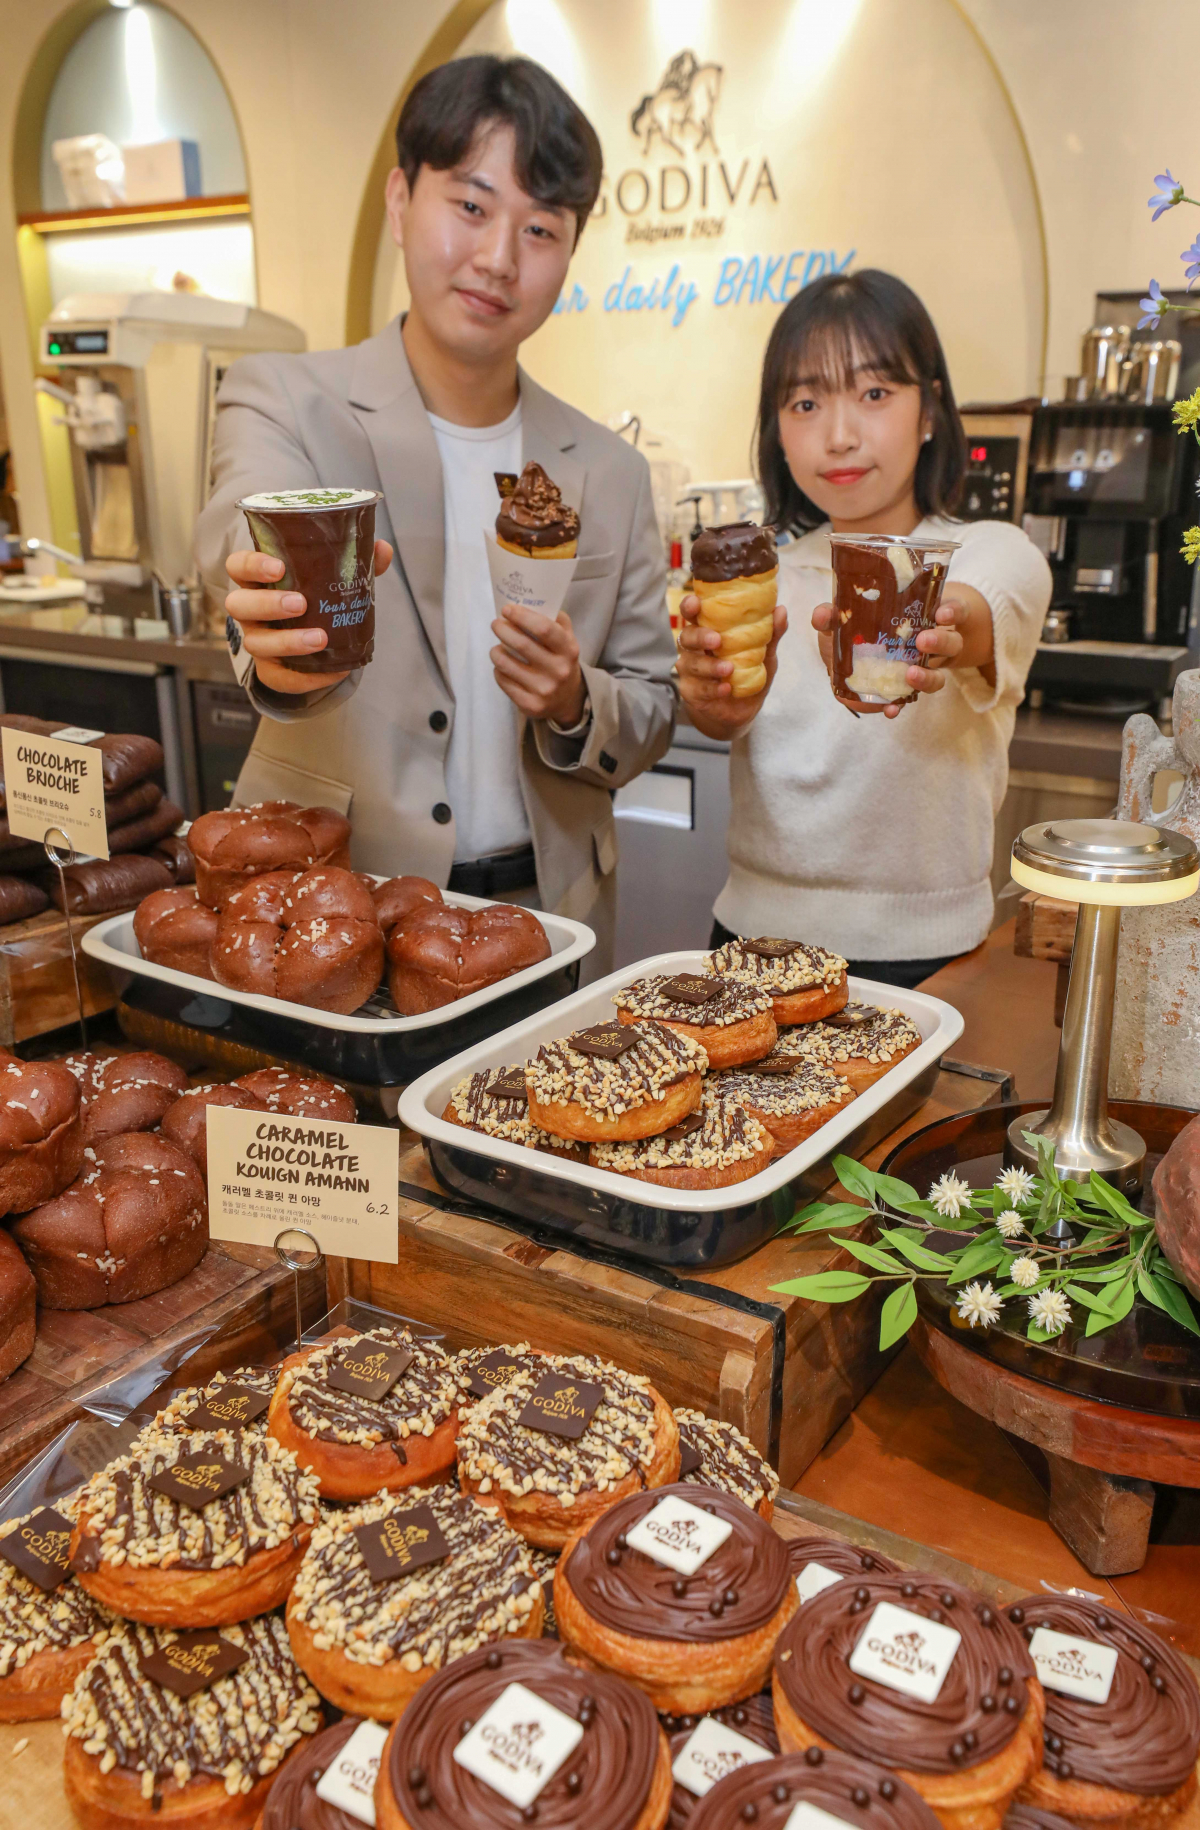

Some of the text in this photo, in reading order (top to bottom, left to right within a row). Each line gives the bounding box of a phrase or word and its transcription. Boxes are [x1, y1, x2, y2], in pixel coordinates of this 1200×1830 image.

[603, 264, 698, 327] daily
[319, 599, 347, 614] Your
[332, 609, 367, 628] BAKERY
[876, 631, 903, 645] Your
[17, 746, 88, 777] CHOCOLATE
[26, 767, 80, 794] BRIOCHE
[49, 799, 69, 811] 브리오슈
[89, 807, 102, 819] 5.8
[671, 981, 708, 995] GODIVA
[583, 1034, 623, 1048] GODIVA
[500, 1079, 526, 1087] GODI
[256, 1122, 349, 1150] CARAMEL
[246, 1142, 360, 1172] CHOCOLATE
[236, 1161, 370, 1193] KOUIGN AMANN
[222, 1184, 321, 1207] 캐러멜 초콜릿 퀸 아망
[365, 1202, 390, 1216] 6.2
[343, 1359, 391, 1382] GODIVA
[477, 1367, 512, 1385] GODI
[206, 1401, 248, 1421] GODIVA
[533, 1396, 586, 1418] GODIVA
[171, 1466, 221, 1492] GODIVA
[21, 1527, 71, 1570] GODIVA
[383, 1518, 412, 1566] GODIVA
[646, 1521, 702, 1555] GODIVA
[165, 1645, 215, 1677] GODIVA
[867, 1638, 936, 1677] GODIVA
[1034, 1653, 1103, 1682] GODIVA
[480, 1724, 544, 1778] GODIVA
